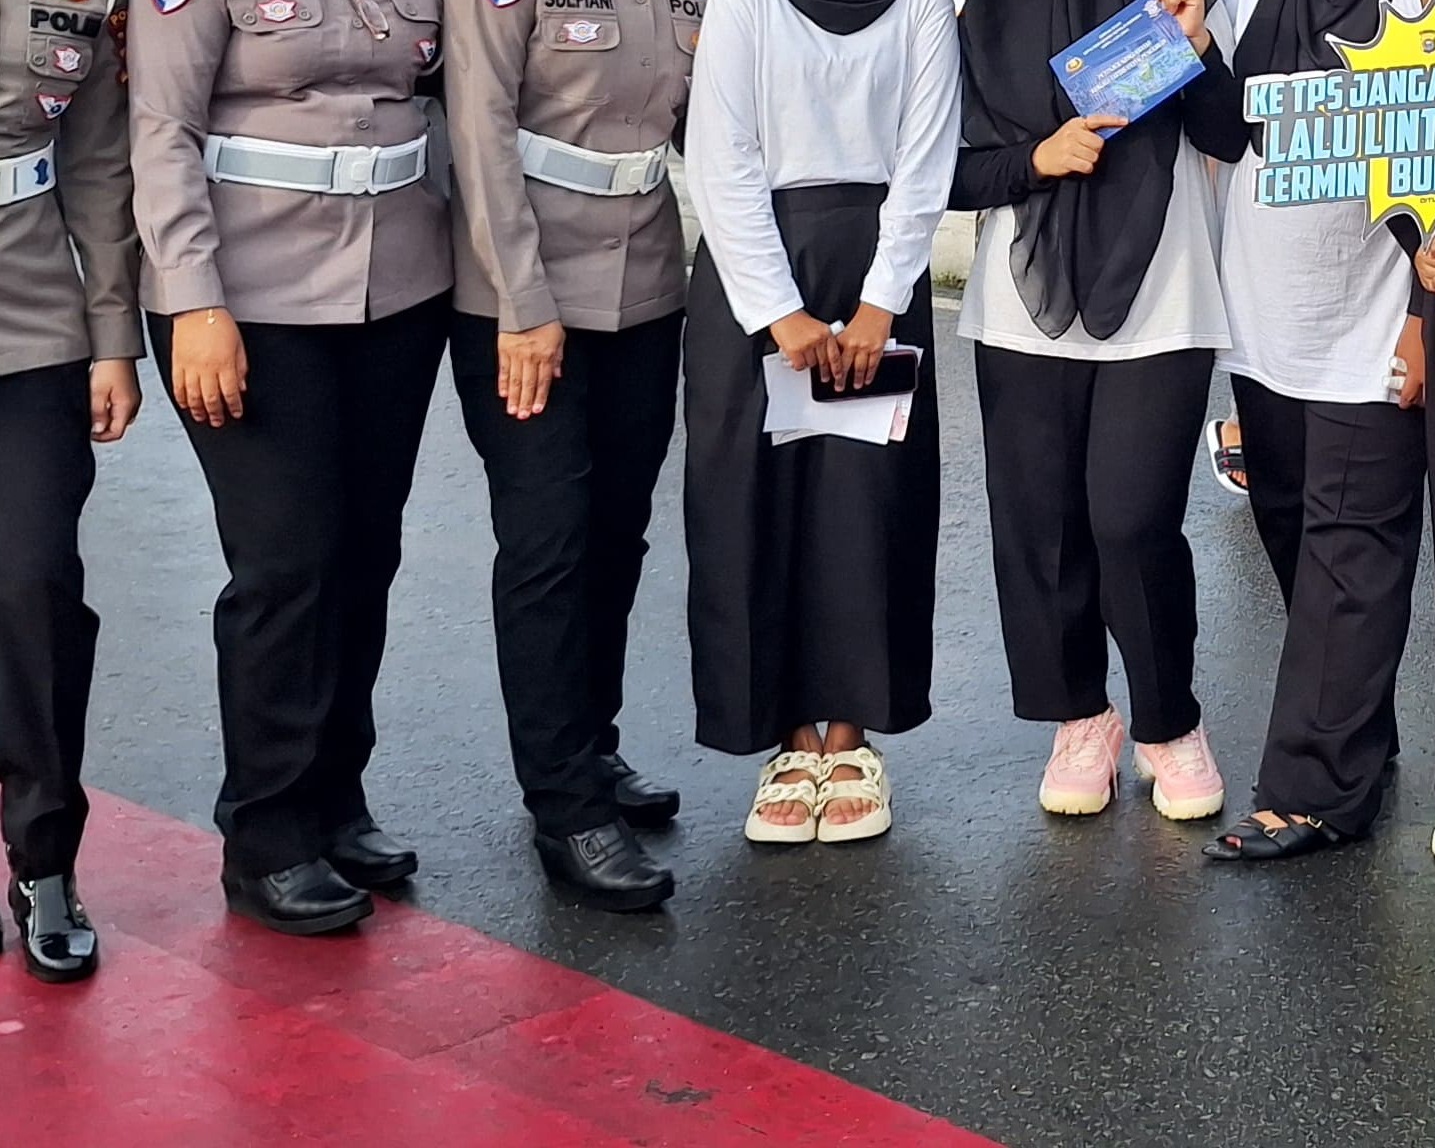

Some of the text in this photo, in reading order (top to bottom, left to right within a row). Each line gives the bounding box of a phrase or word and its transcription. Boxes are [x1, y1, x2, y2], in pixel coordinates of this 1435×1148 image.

[1250, 82, 1284, 117] KE
[1293, 76, 1343, 113] TPS
[1267, 114, 1357, 164] LALU
[1258, 159, 1368, 206] CERMIN
